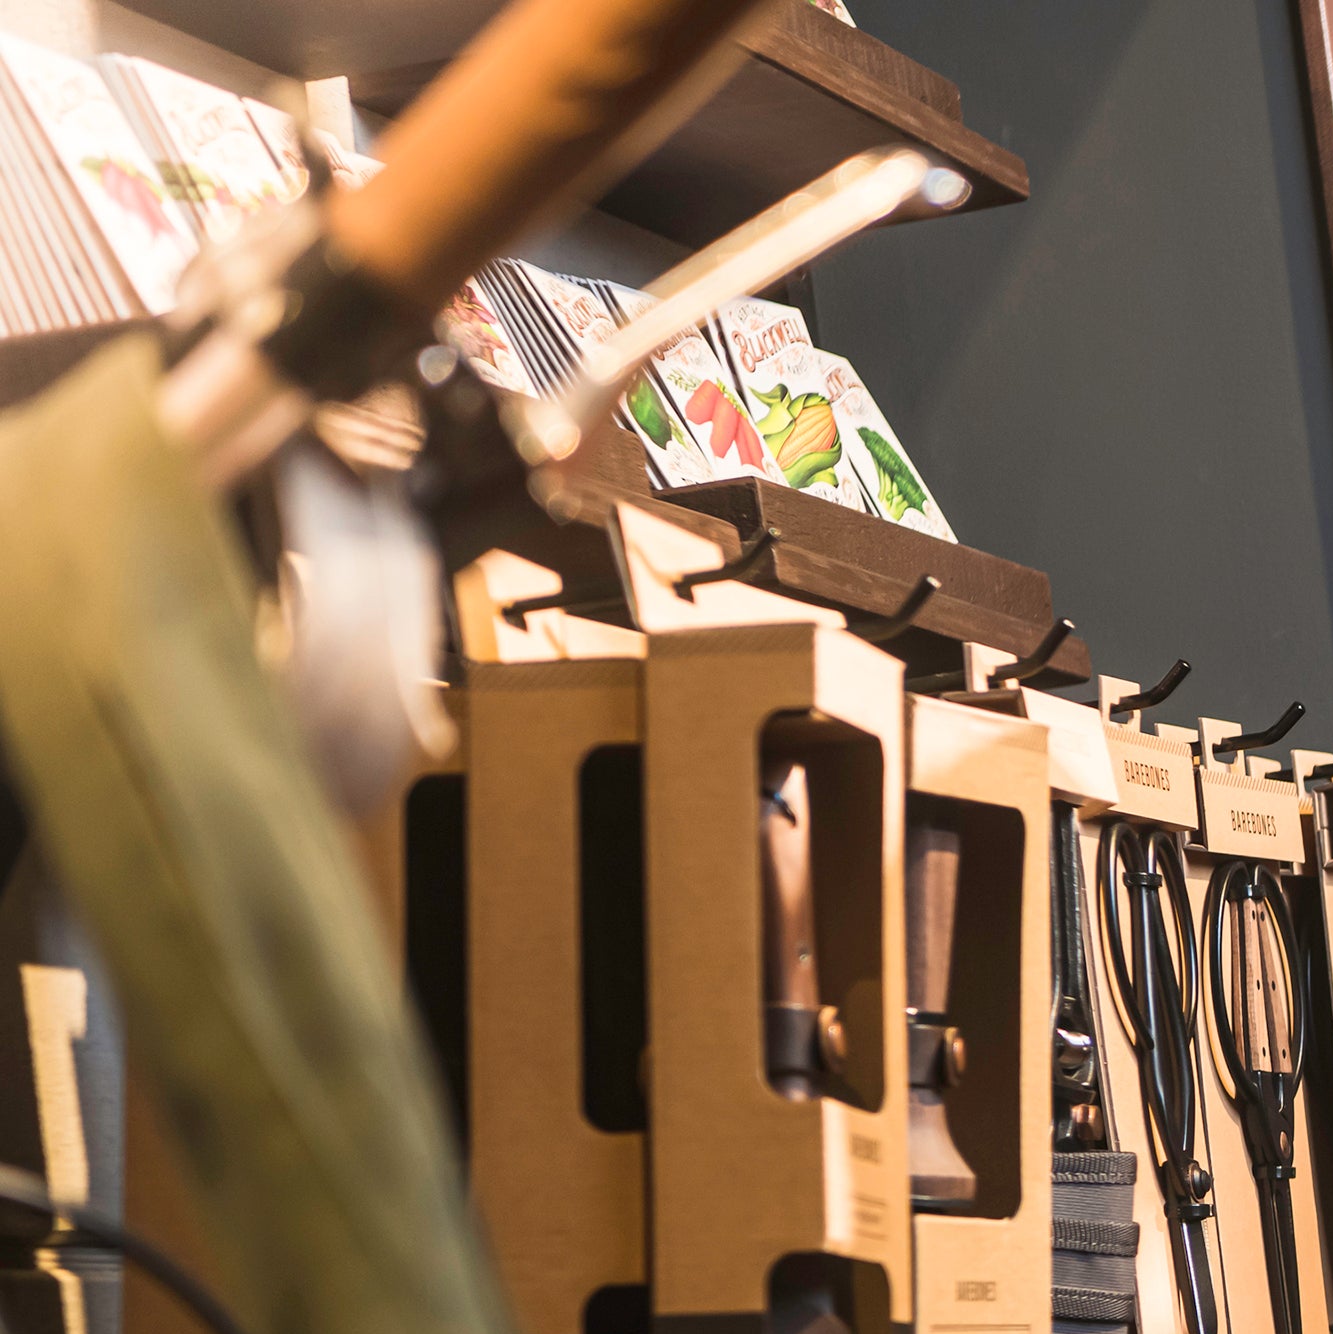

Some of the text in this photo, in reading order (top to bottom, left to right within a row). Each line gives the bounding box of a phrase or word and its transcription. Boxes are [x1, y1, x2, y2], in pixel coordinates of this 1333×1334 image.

[731, 318, 809, 374] BLACKWELL
[1124, 759, 1170, 792] BAREBONES
[1230, 809, 1277, 837] BAREBONES
